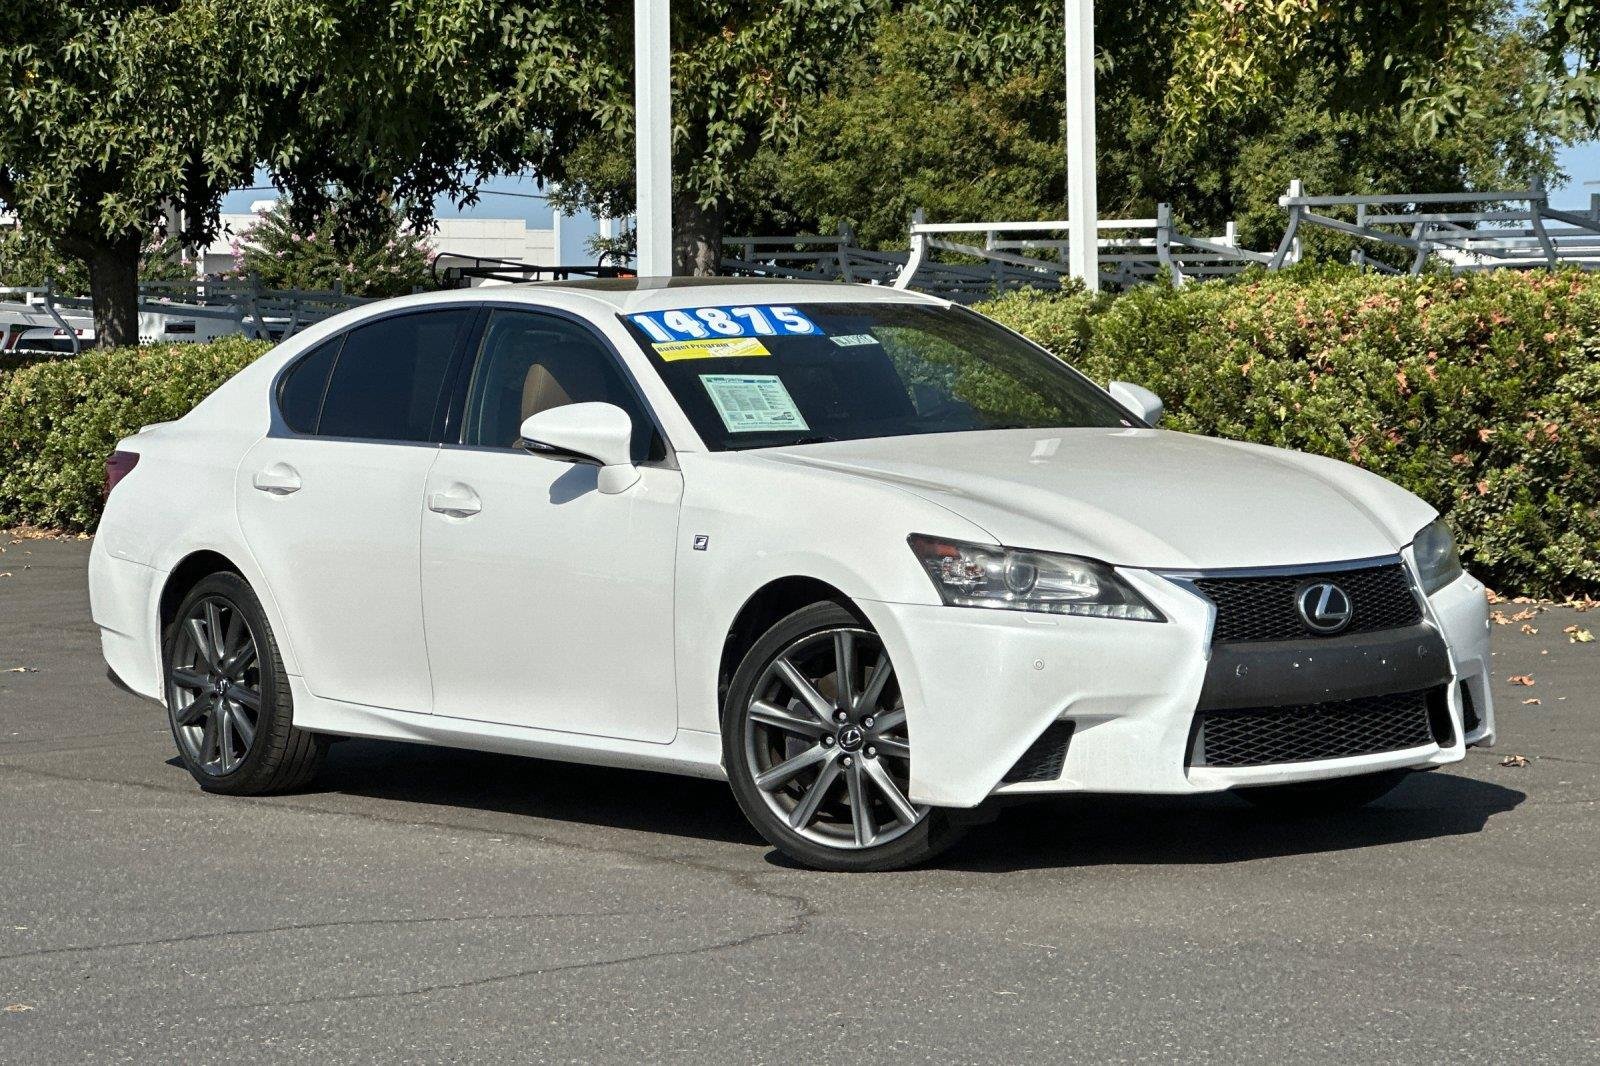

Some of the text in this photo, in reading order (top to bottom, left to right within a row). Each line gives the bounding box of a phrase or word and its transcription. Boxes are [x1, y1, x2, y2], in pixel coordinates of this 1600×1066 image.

[633, 306, 814, 341] 14875
[656, 342, 730, 352] Budget Program
